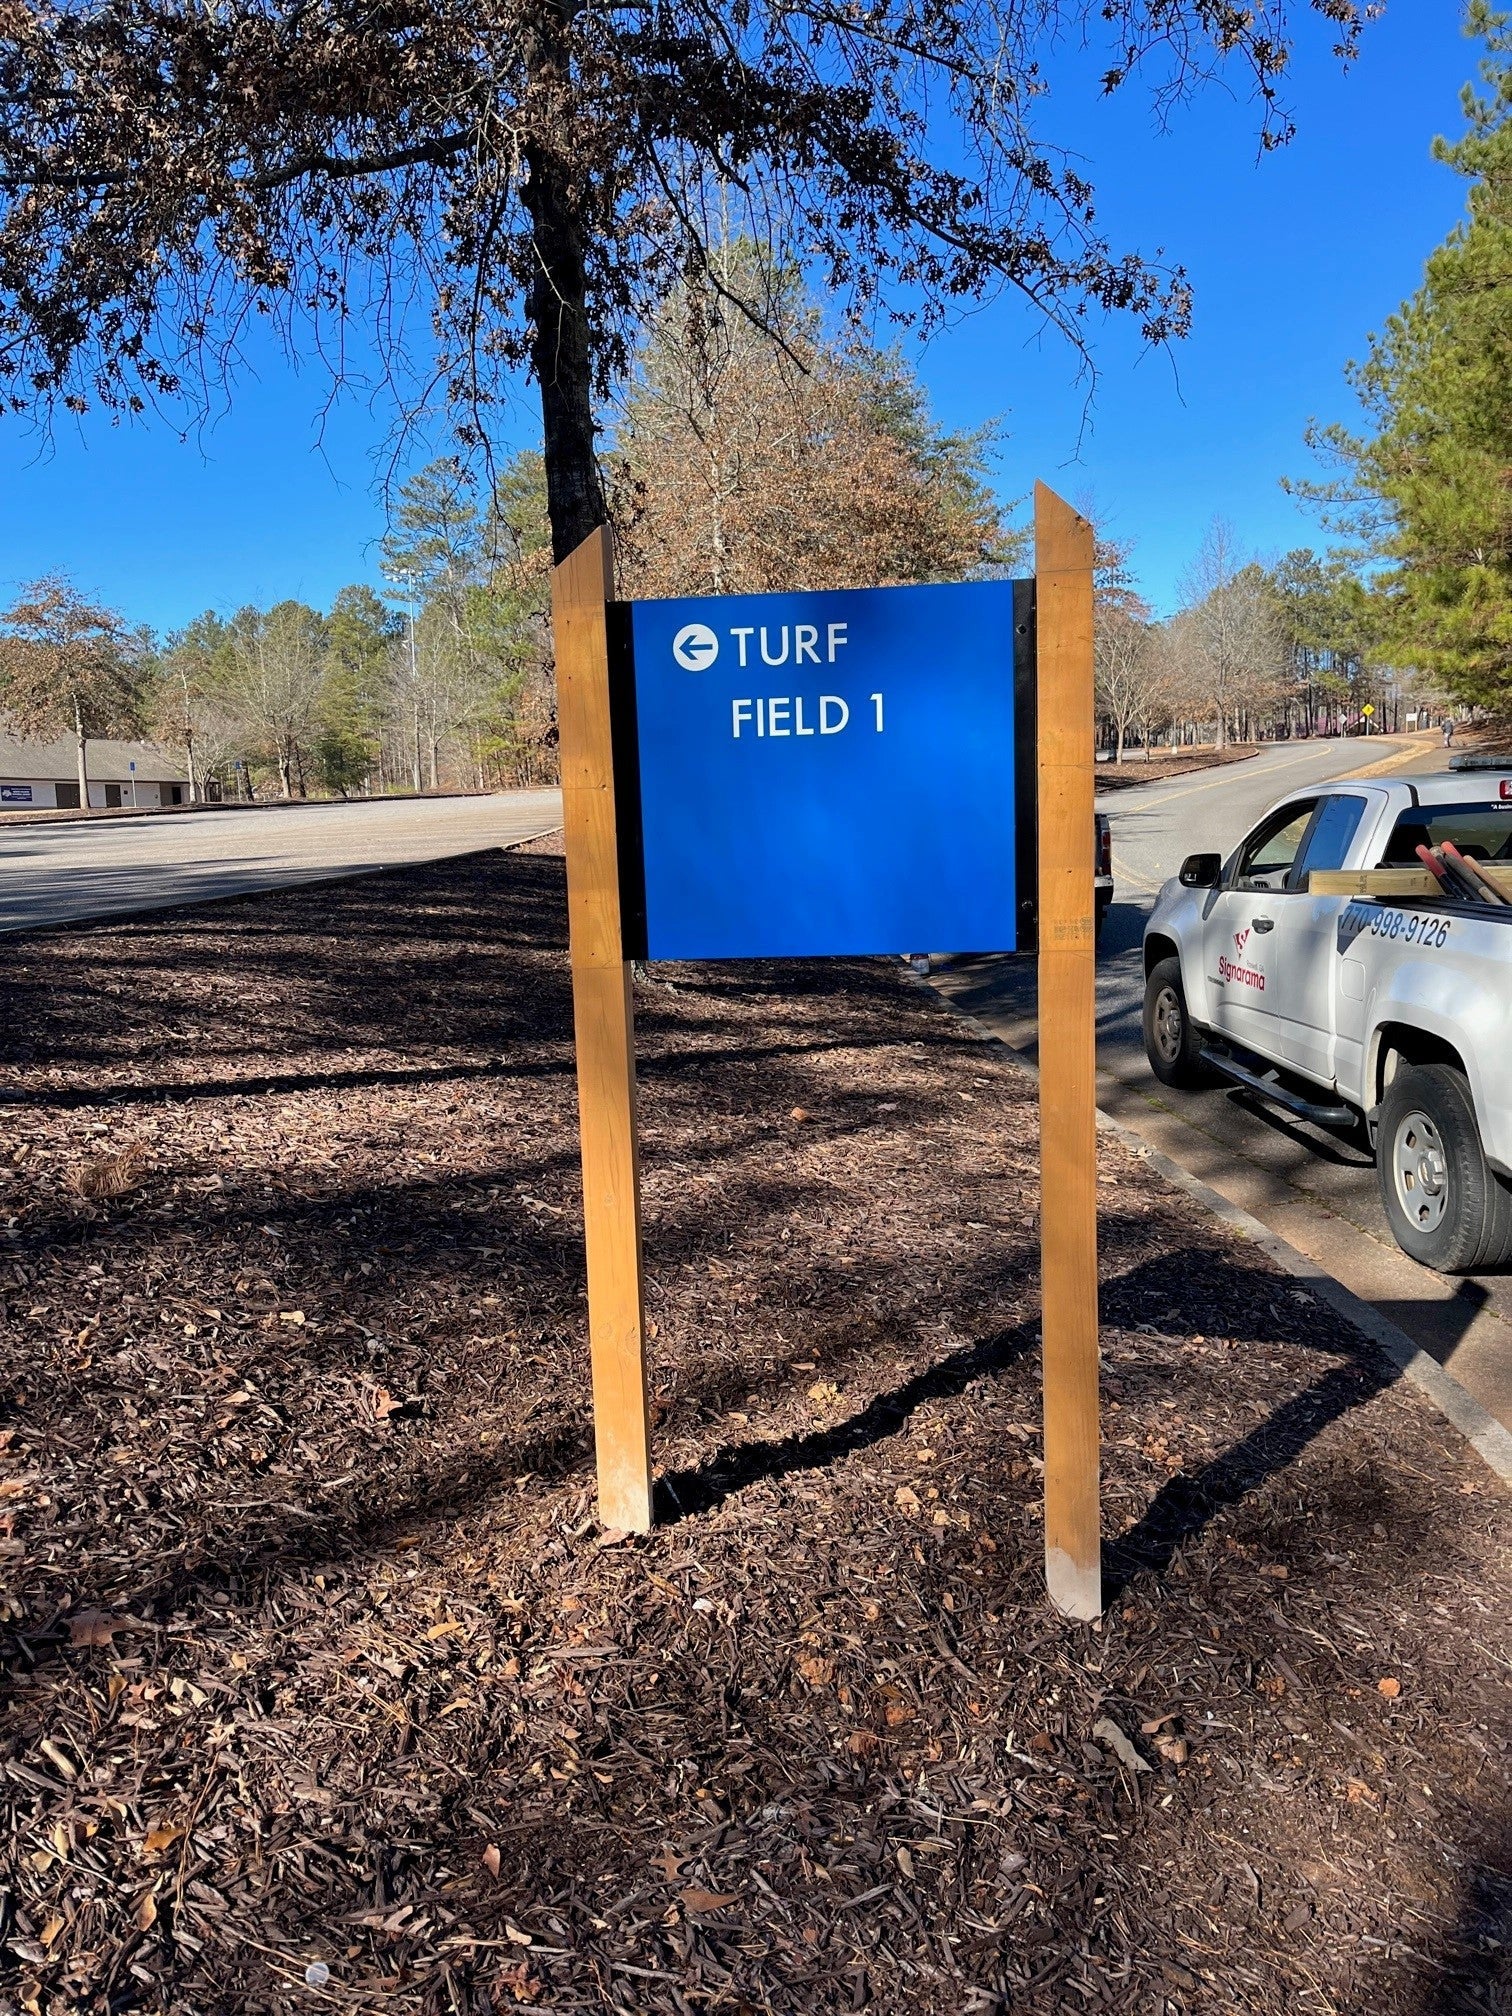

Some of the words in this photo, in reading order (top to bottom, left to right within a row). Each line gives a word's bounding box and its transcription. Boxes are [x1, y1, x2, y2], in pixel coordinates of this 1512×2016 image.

[730, 622, 848, 667] TURF
[732, 695, 849, 738] FIELD
[870, 693, 884, 732] 1
[1341, 904, 1452, 949] 770-998-9126
[1218, 955, 1266, 991] Signarama
